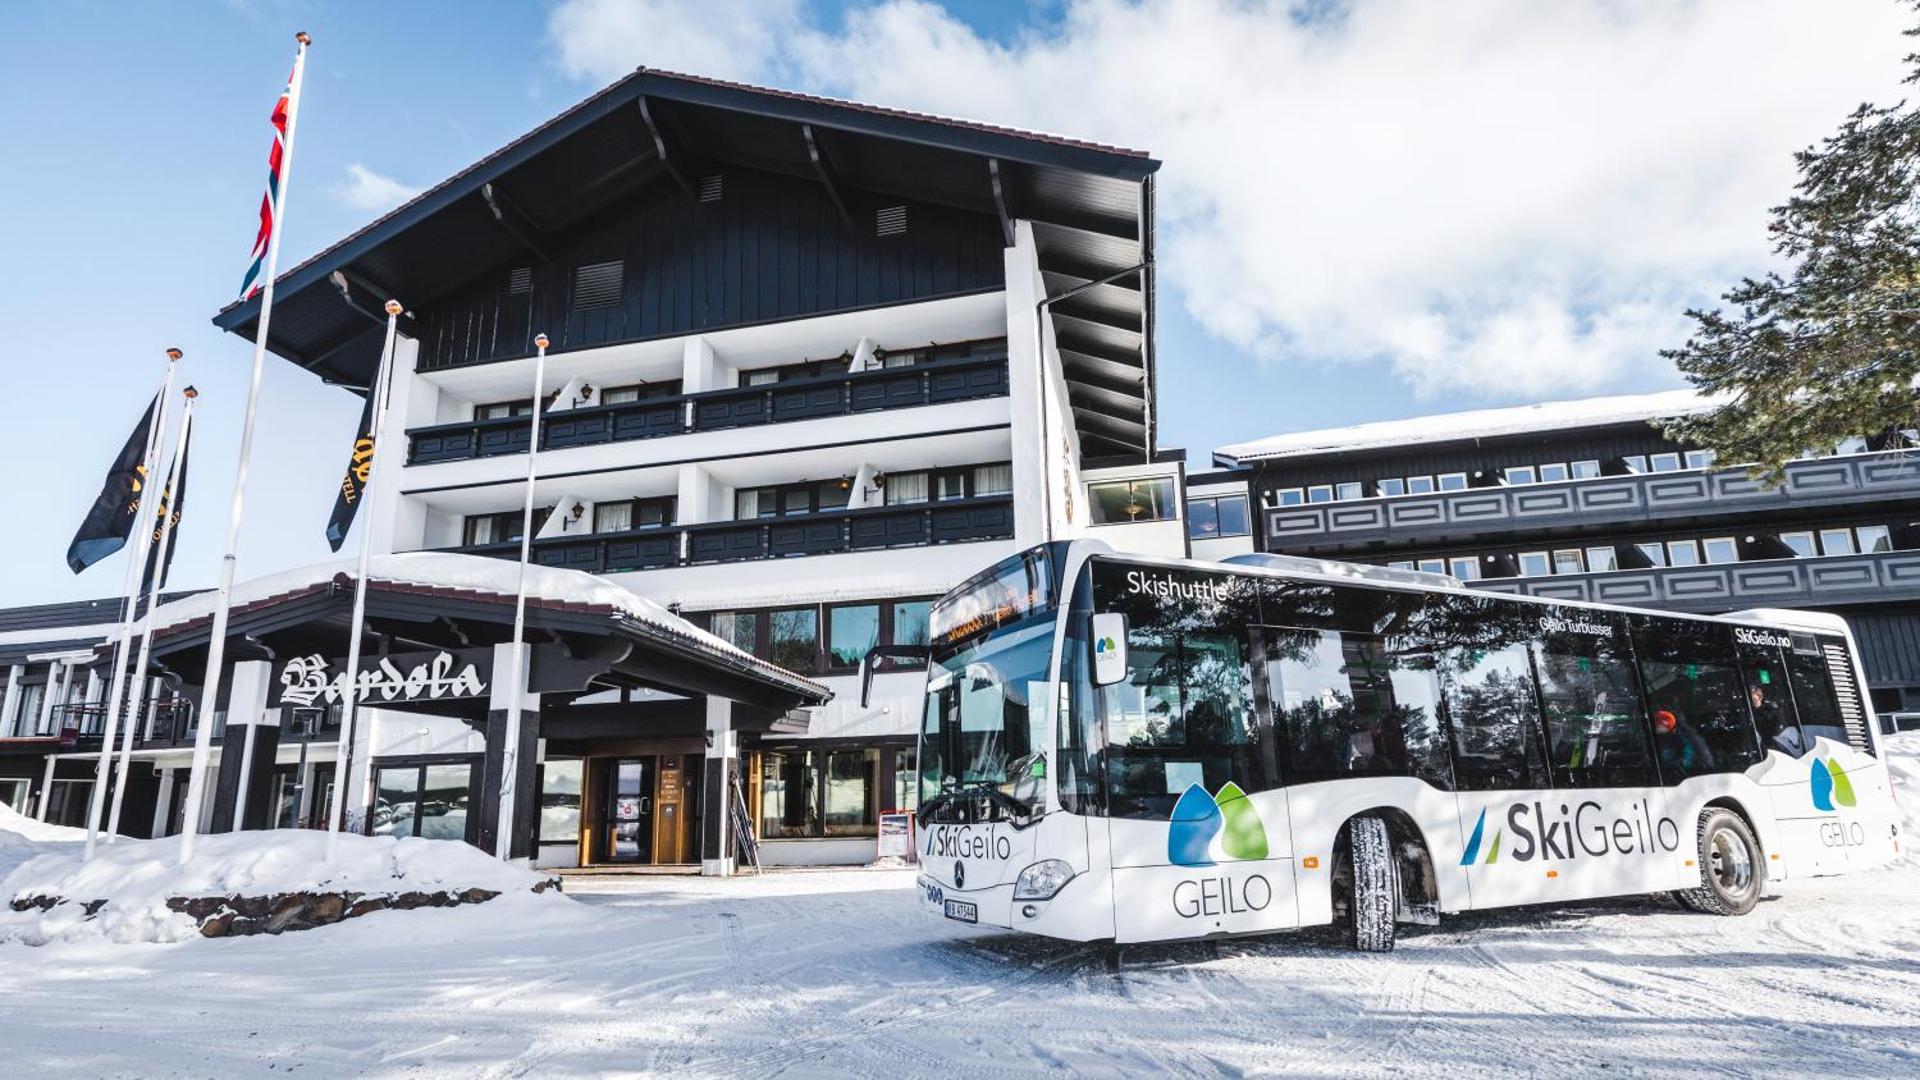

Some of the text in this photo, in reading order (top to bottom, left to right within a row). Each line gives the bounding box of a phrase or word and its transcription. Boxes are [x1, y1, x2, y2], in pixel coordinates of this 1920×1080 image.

[1127, 571, 1227, 601] Skishuttle
[1539, 616, 1613, 638] Geilo Turbusser
[1735, 627, 1791, 647] SkiGeilo.no
[280, 650, 487, 707] Bardøla
[937, 823, 1011, 860] SkiGeilo
[1507, 798, 1679, 862] SkiGeilo
[1820, 821, 1865, 847] GEILO
[1172, 874, 1272, 918] GEILO
